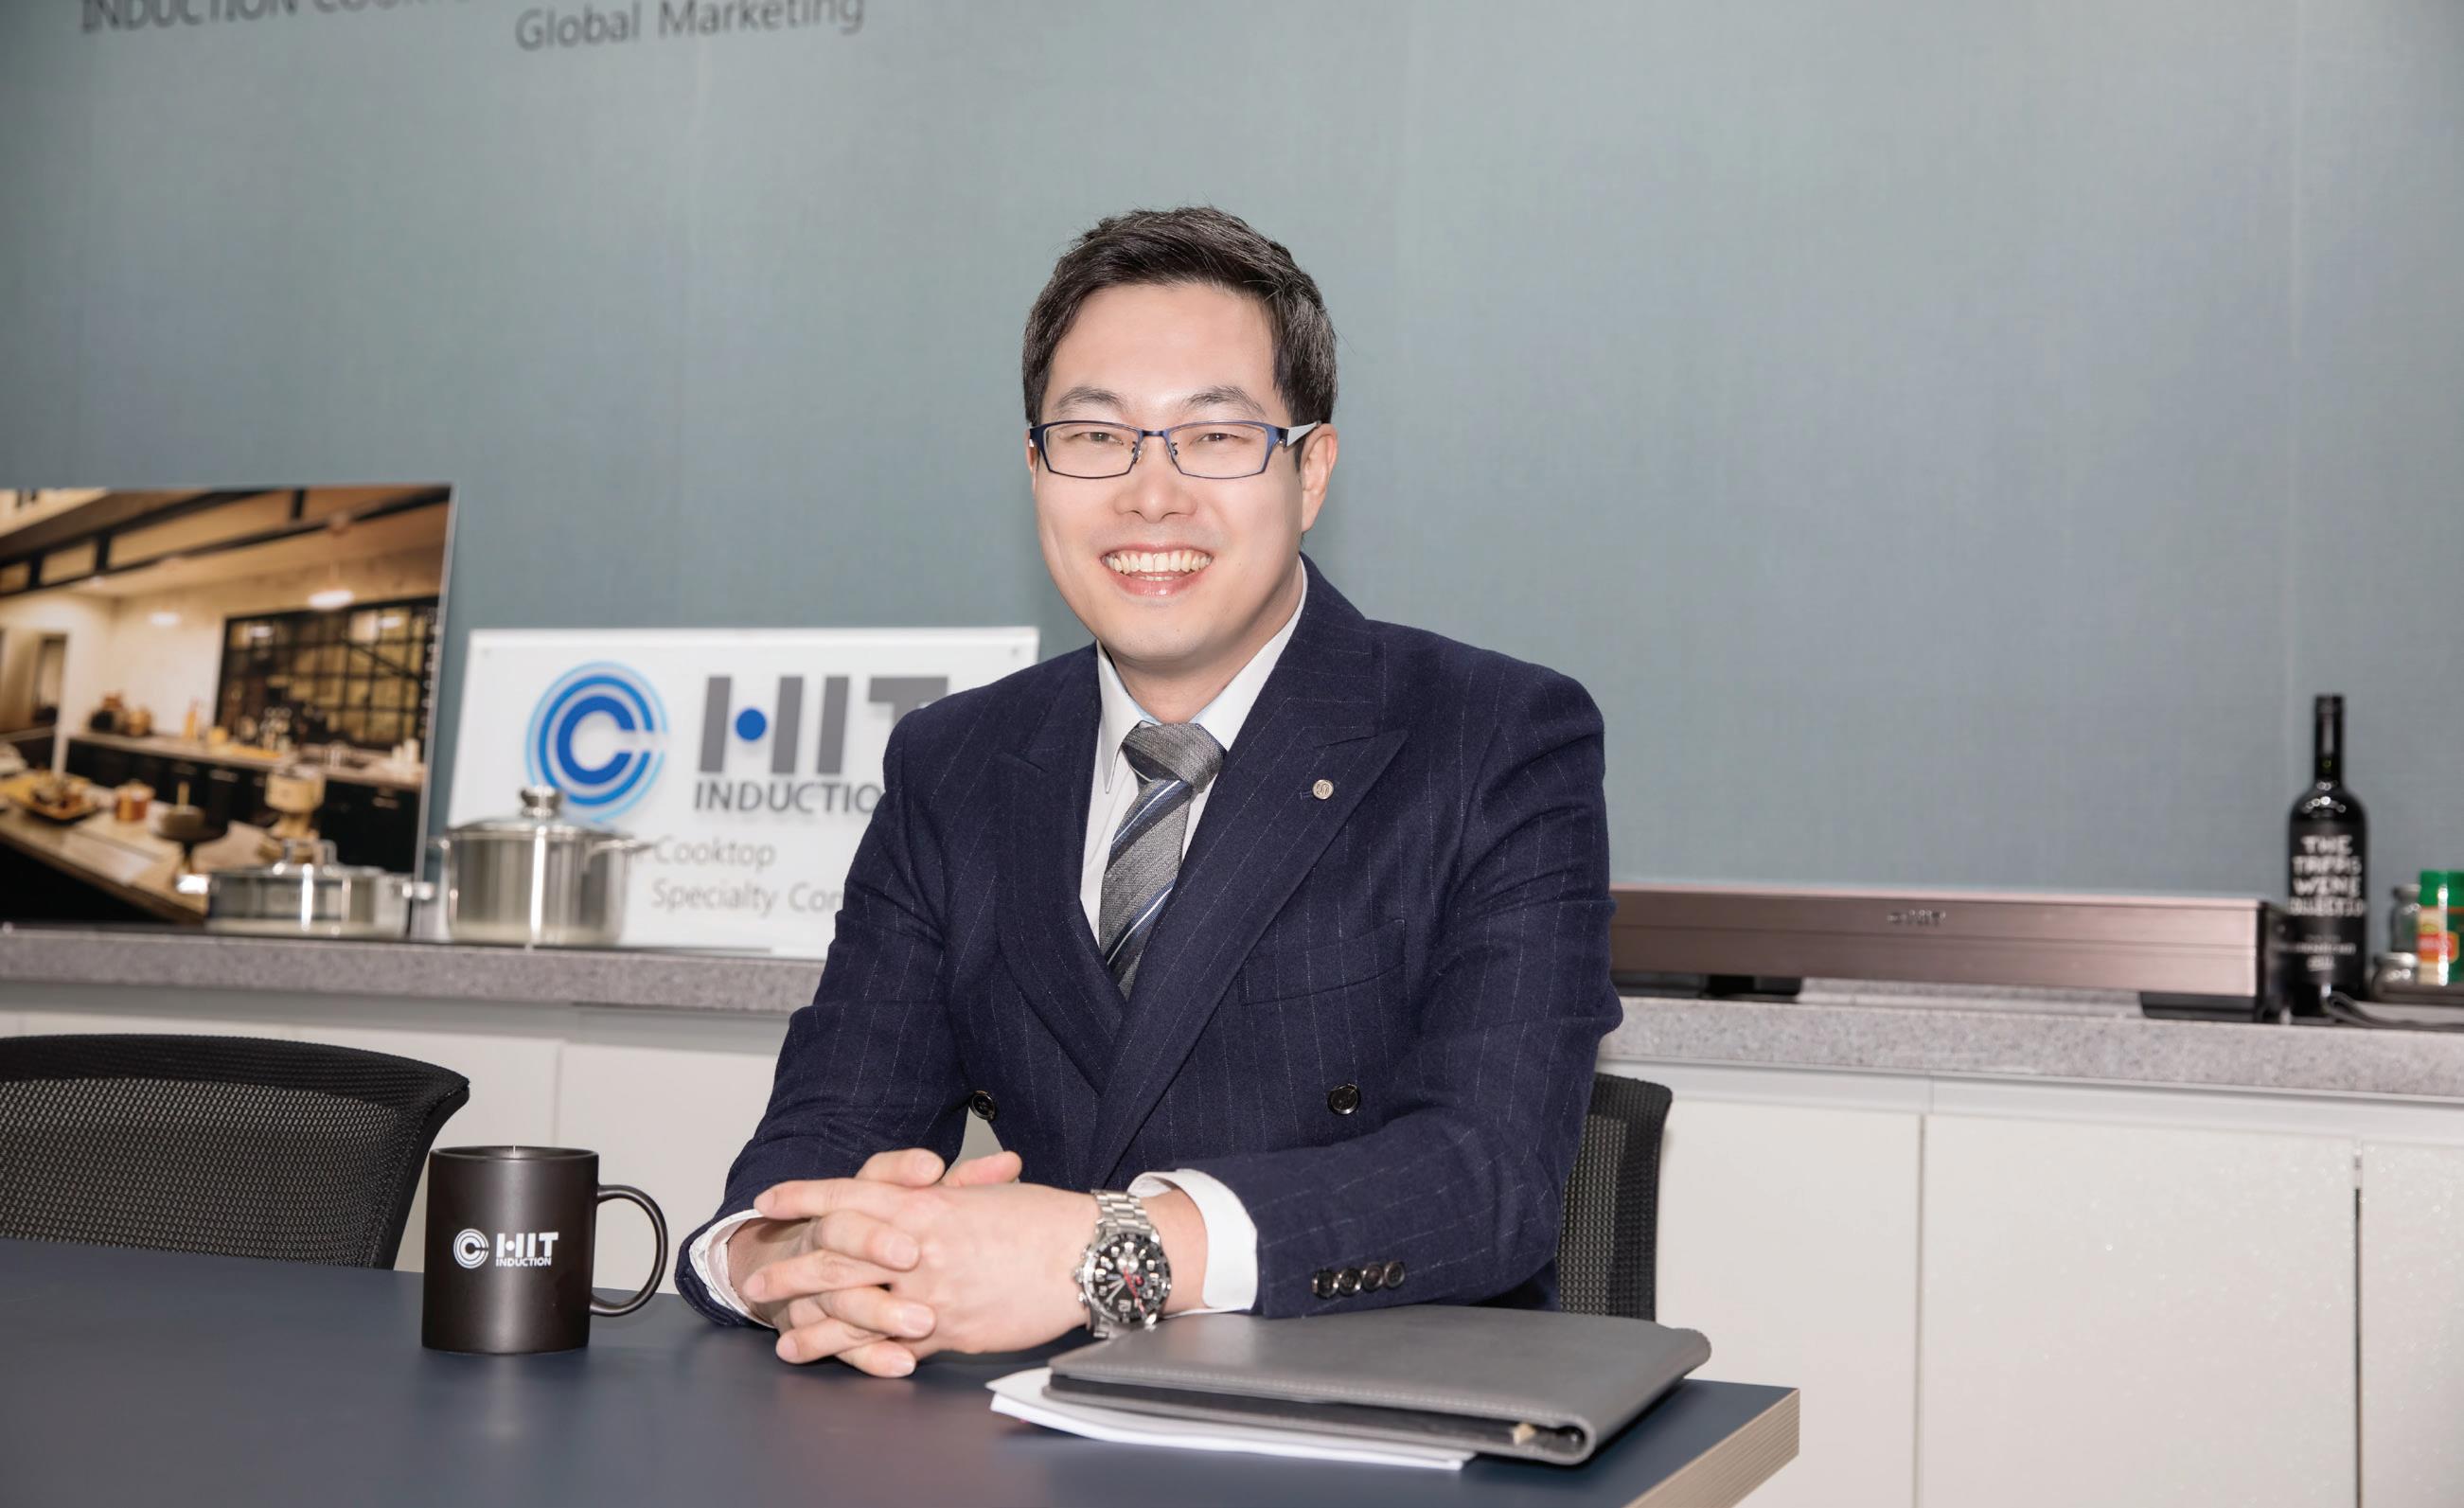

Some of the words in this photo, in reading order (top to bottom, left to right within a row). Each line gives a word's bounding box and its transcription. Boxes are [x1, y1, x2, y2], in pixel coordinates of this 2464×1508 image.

[515, 2, 641, 51] Global
[658, 0, 864, 38] Marketing
[699, 675, 948, 775] HIT
[694, 780, 882, 814] INDUCTIO
[653, 833, 777, 873] Cooktop
[2300, 834, 2353, 854] THE
[651, 876, 779, 919] Specialty
[2293, 876, 2362, 897] WINE
[496, 1232, 559, 1258] HIT
[495, 1257, 552, 1268] INDUCTION
